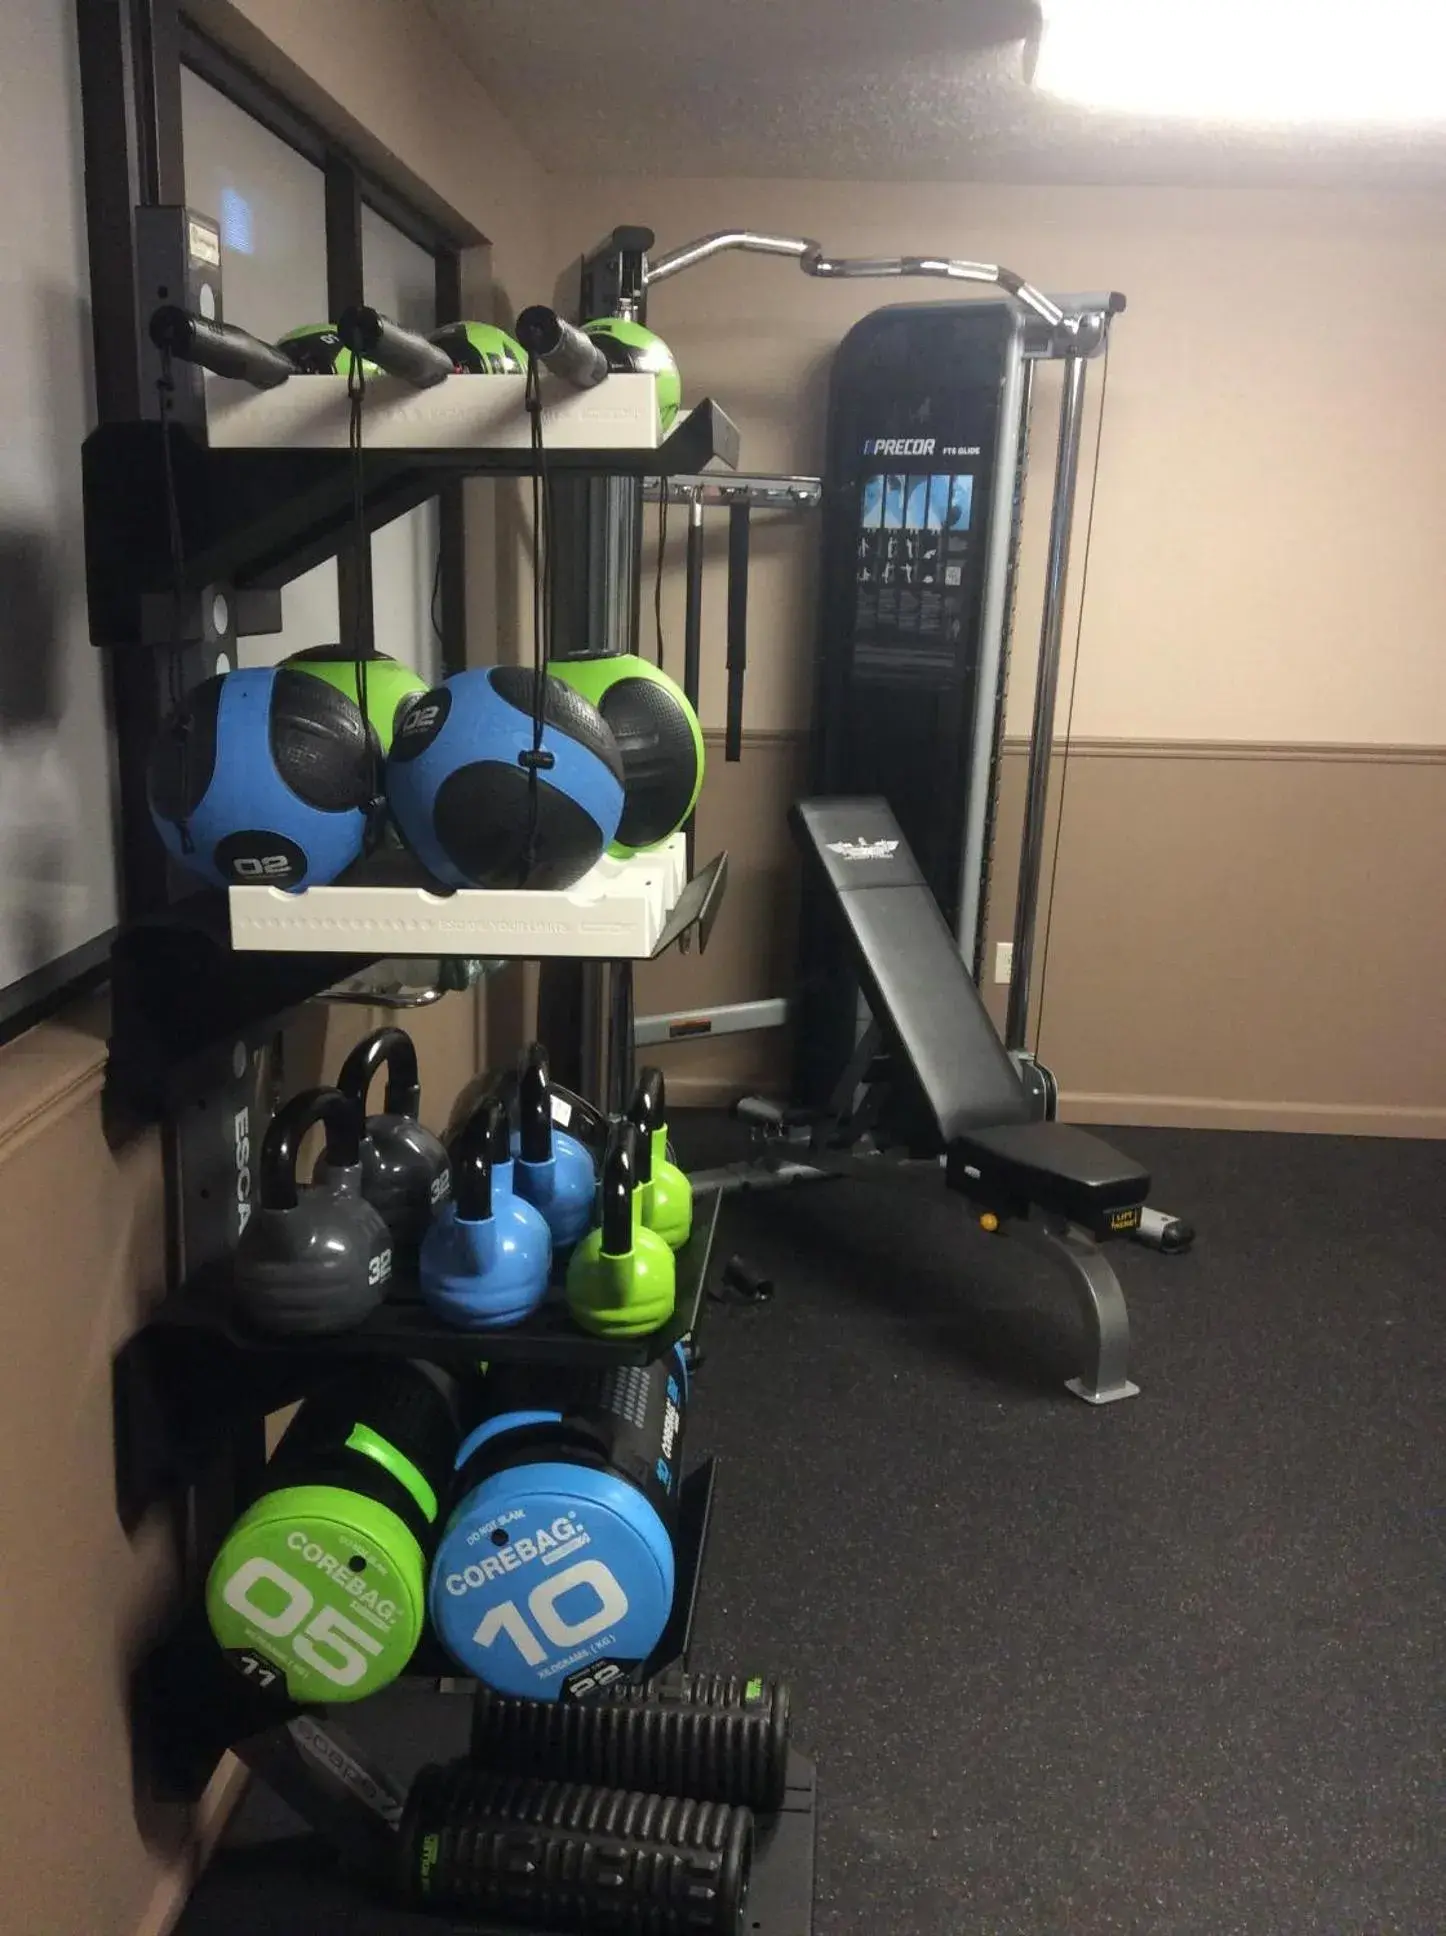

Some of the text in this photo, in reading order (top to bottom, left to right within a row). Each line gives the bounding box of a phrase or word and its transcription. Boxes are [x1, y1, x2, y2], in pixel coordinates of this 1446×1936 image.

[874, 438, 936, 456] PRECOR
[404, 705, 440, 733] 02
[233, 855, 292, 877] 02
[223, 1556, 385, 1687] 05
[472, 1559, 629, 1667] 10
[240, 1655, 277, 1688] 11
